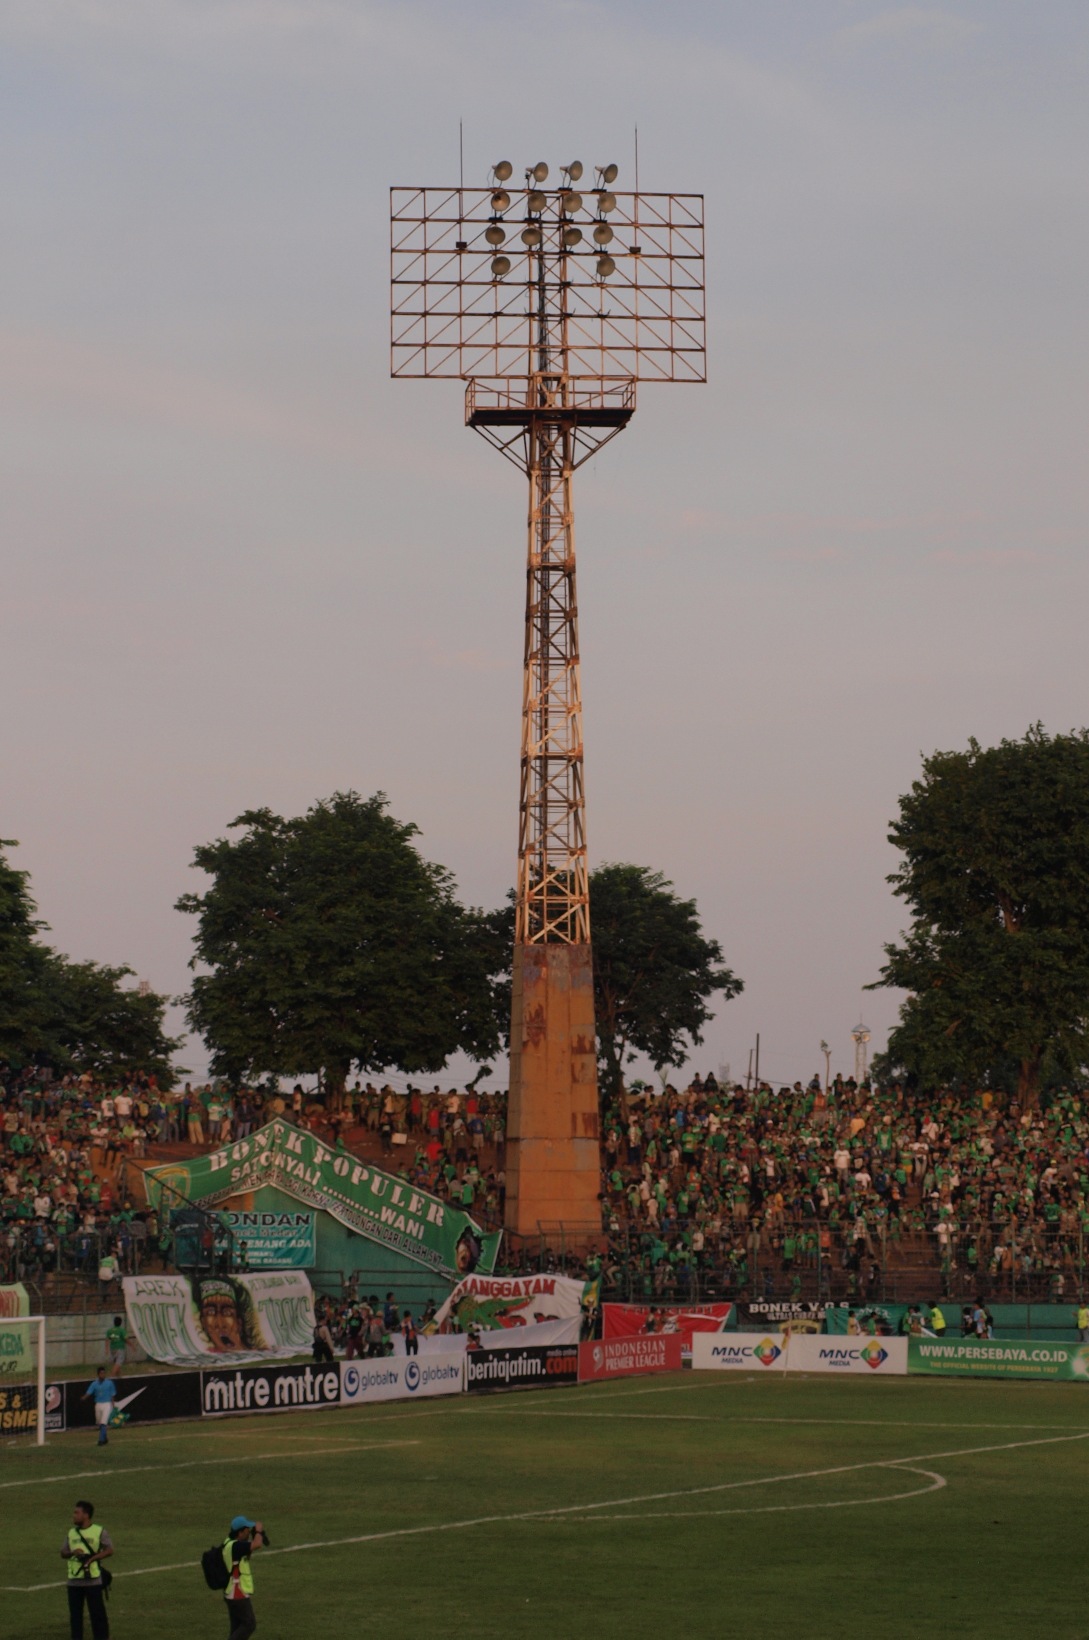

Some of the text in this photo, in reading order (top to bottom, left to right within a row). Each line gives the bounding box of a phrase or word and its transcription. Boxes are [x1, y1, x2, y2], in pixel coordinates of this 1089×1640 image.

[209, 1124, 306, 1172] BONEK
[312, 1144, 445, 1227] POPULER
[134, 1279, 185, 1298] AREK
[749, 1302, 803, 1314] BONEK
[605, 1340, 666, 1357] INDONESIAN
[711, 1347, 753, 1357] MNC
[819, 1349, 860, 1360] MNC
[919, 1344, 1068, 1362] WWW.PERSEBAYA.CO.ID
[467, 1351, 577, 1382] beritajatim.com
[605, 1353, 666, 1372] PREMIER LEAGUE
[361, 1370, 399, 1391] globaltv
[422, 1364, 460, 1384] globaltv
[205, 1366, 339, 1411] mitre mitre
